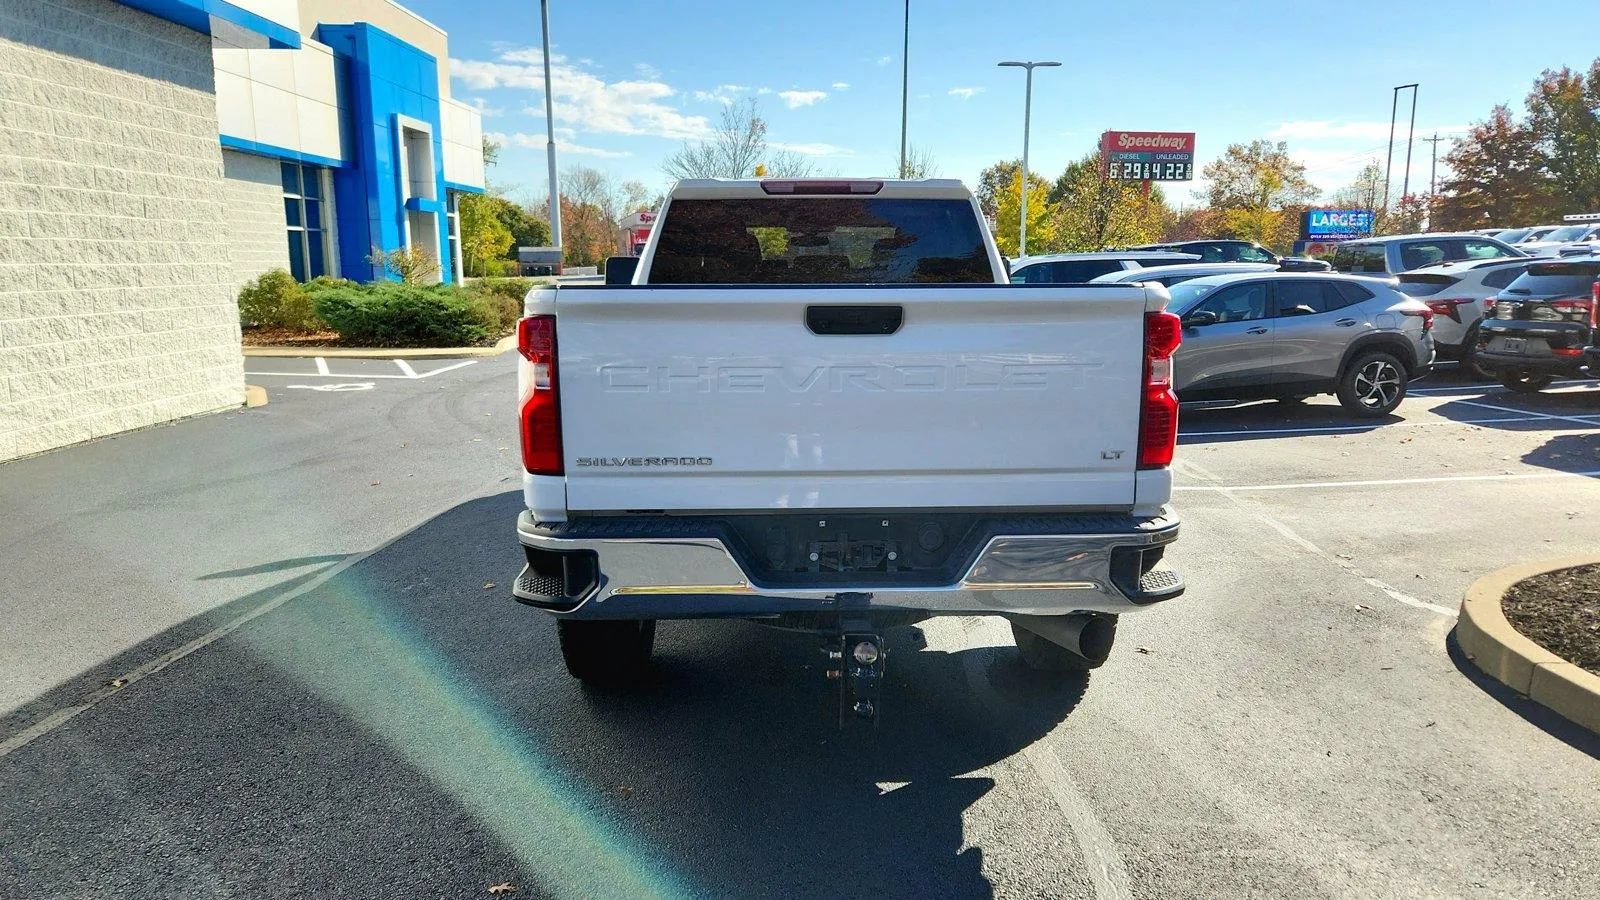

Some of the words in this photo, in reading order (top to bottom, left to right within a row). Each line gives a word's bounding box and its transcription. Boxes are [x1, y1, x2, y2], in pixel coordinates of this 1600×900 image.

[1118, 133, 1187, 150] Speedway
[599, 365, 1103, 393] CHEVROLET
[576, 456, 713, 467] SILVERADO
[1101, 450, 1125, 460] LT
